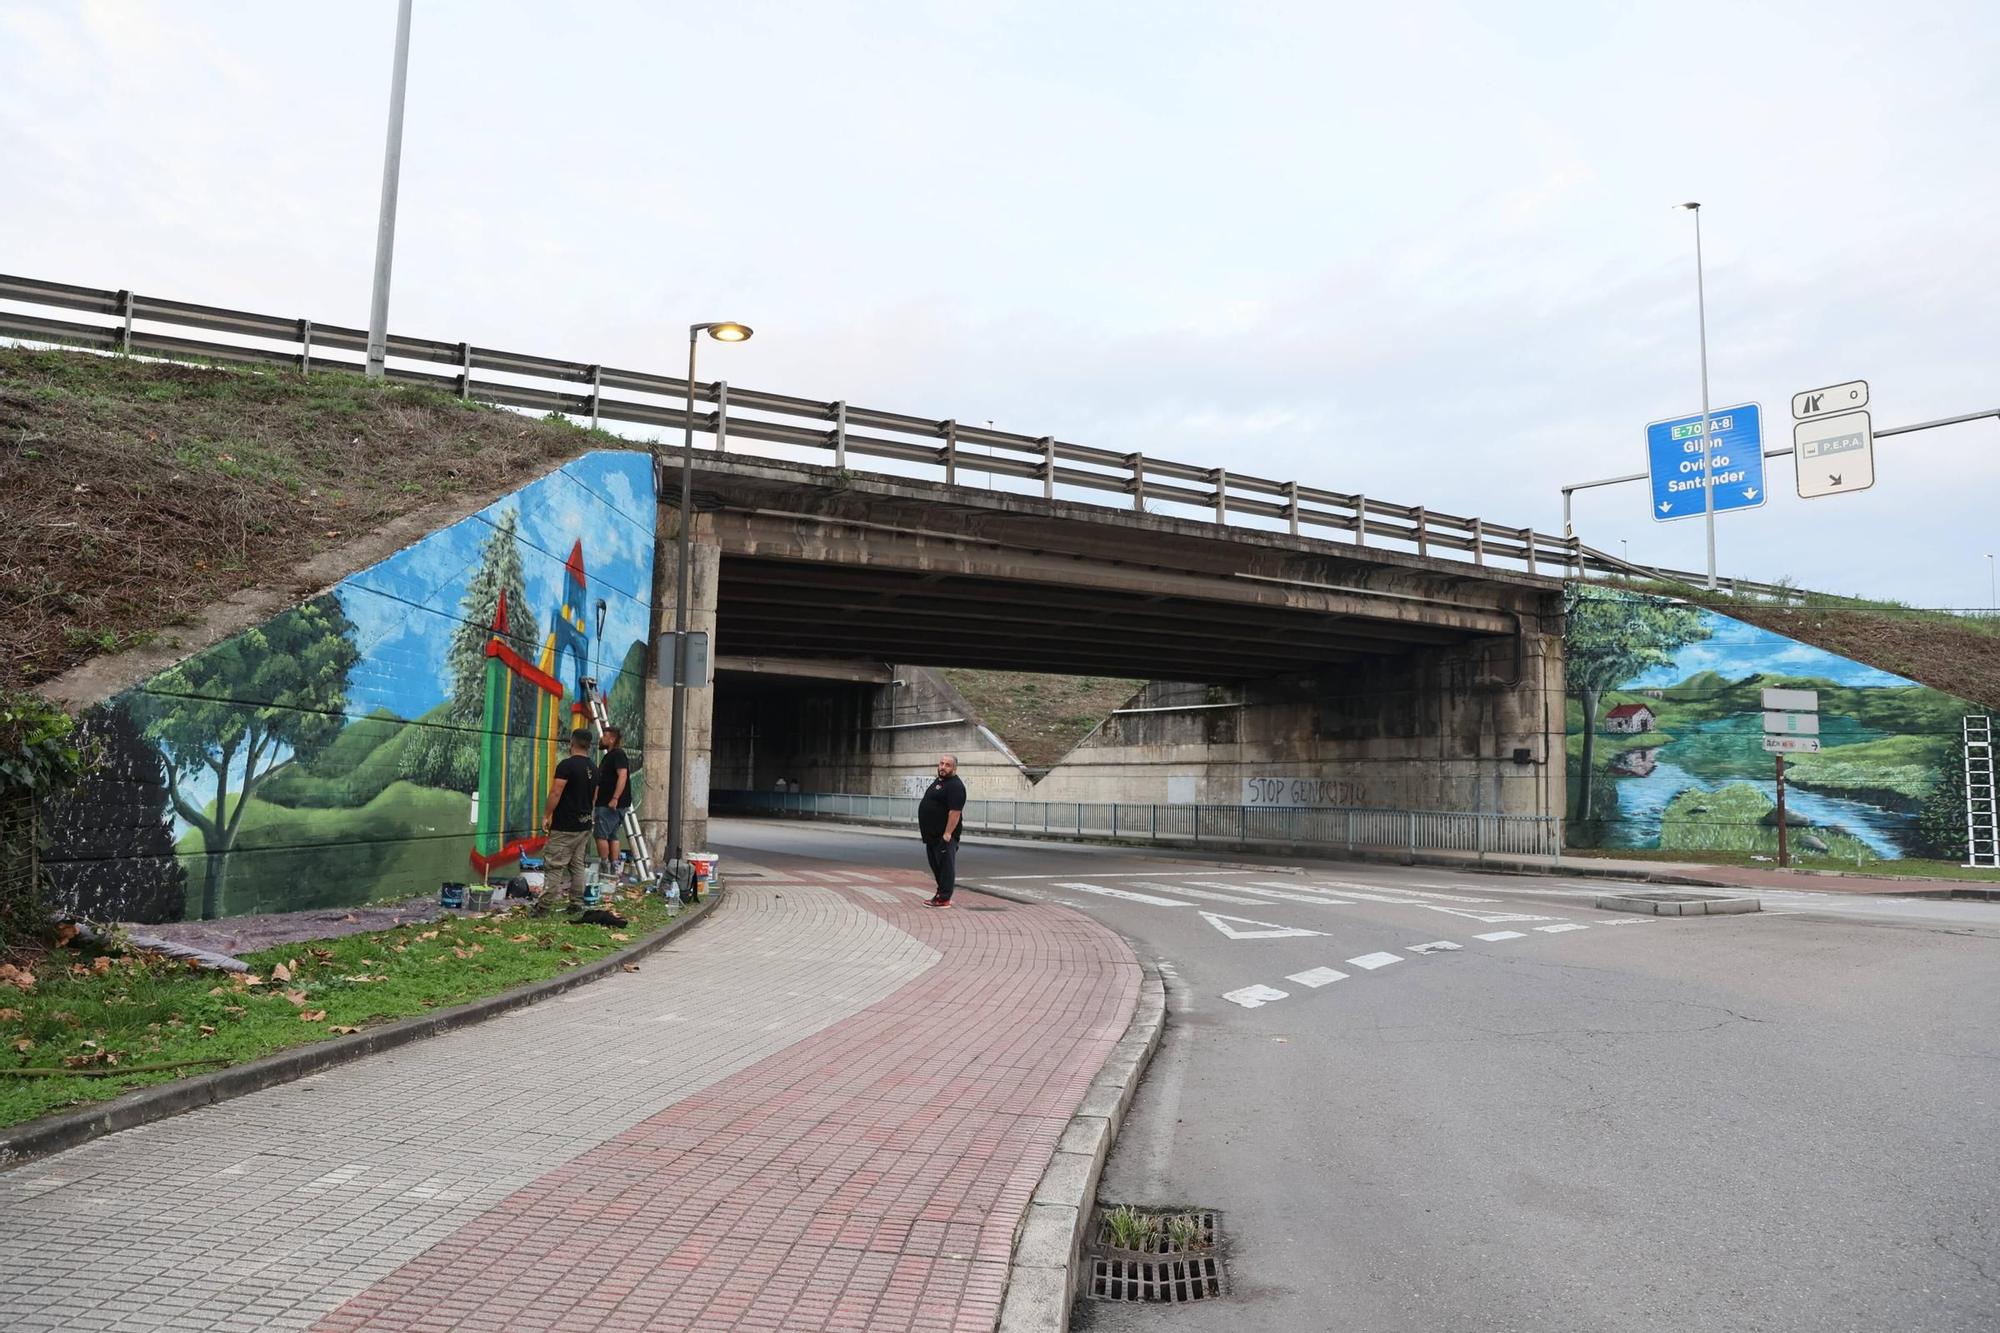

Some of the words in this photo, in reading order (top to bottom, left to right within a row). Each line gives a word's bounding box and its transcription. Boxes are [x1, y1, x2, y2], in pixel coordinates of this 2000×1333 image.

[1673, 425, 1701, 438] E-70
[1710, 418, 1730, 431] A-8
[1248, 776, 1284, 804] STOP
